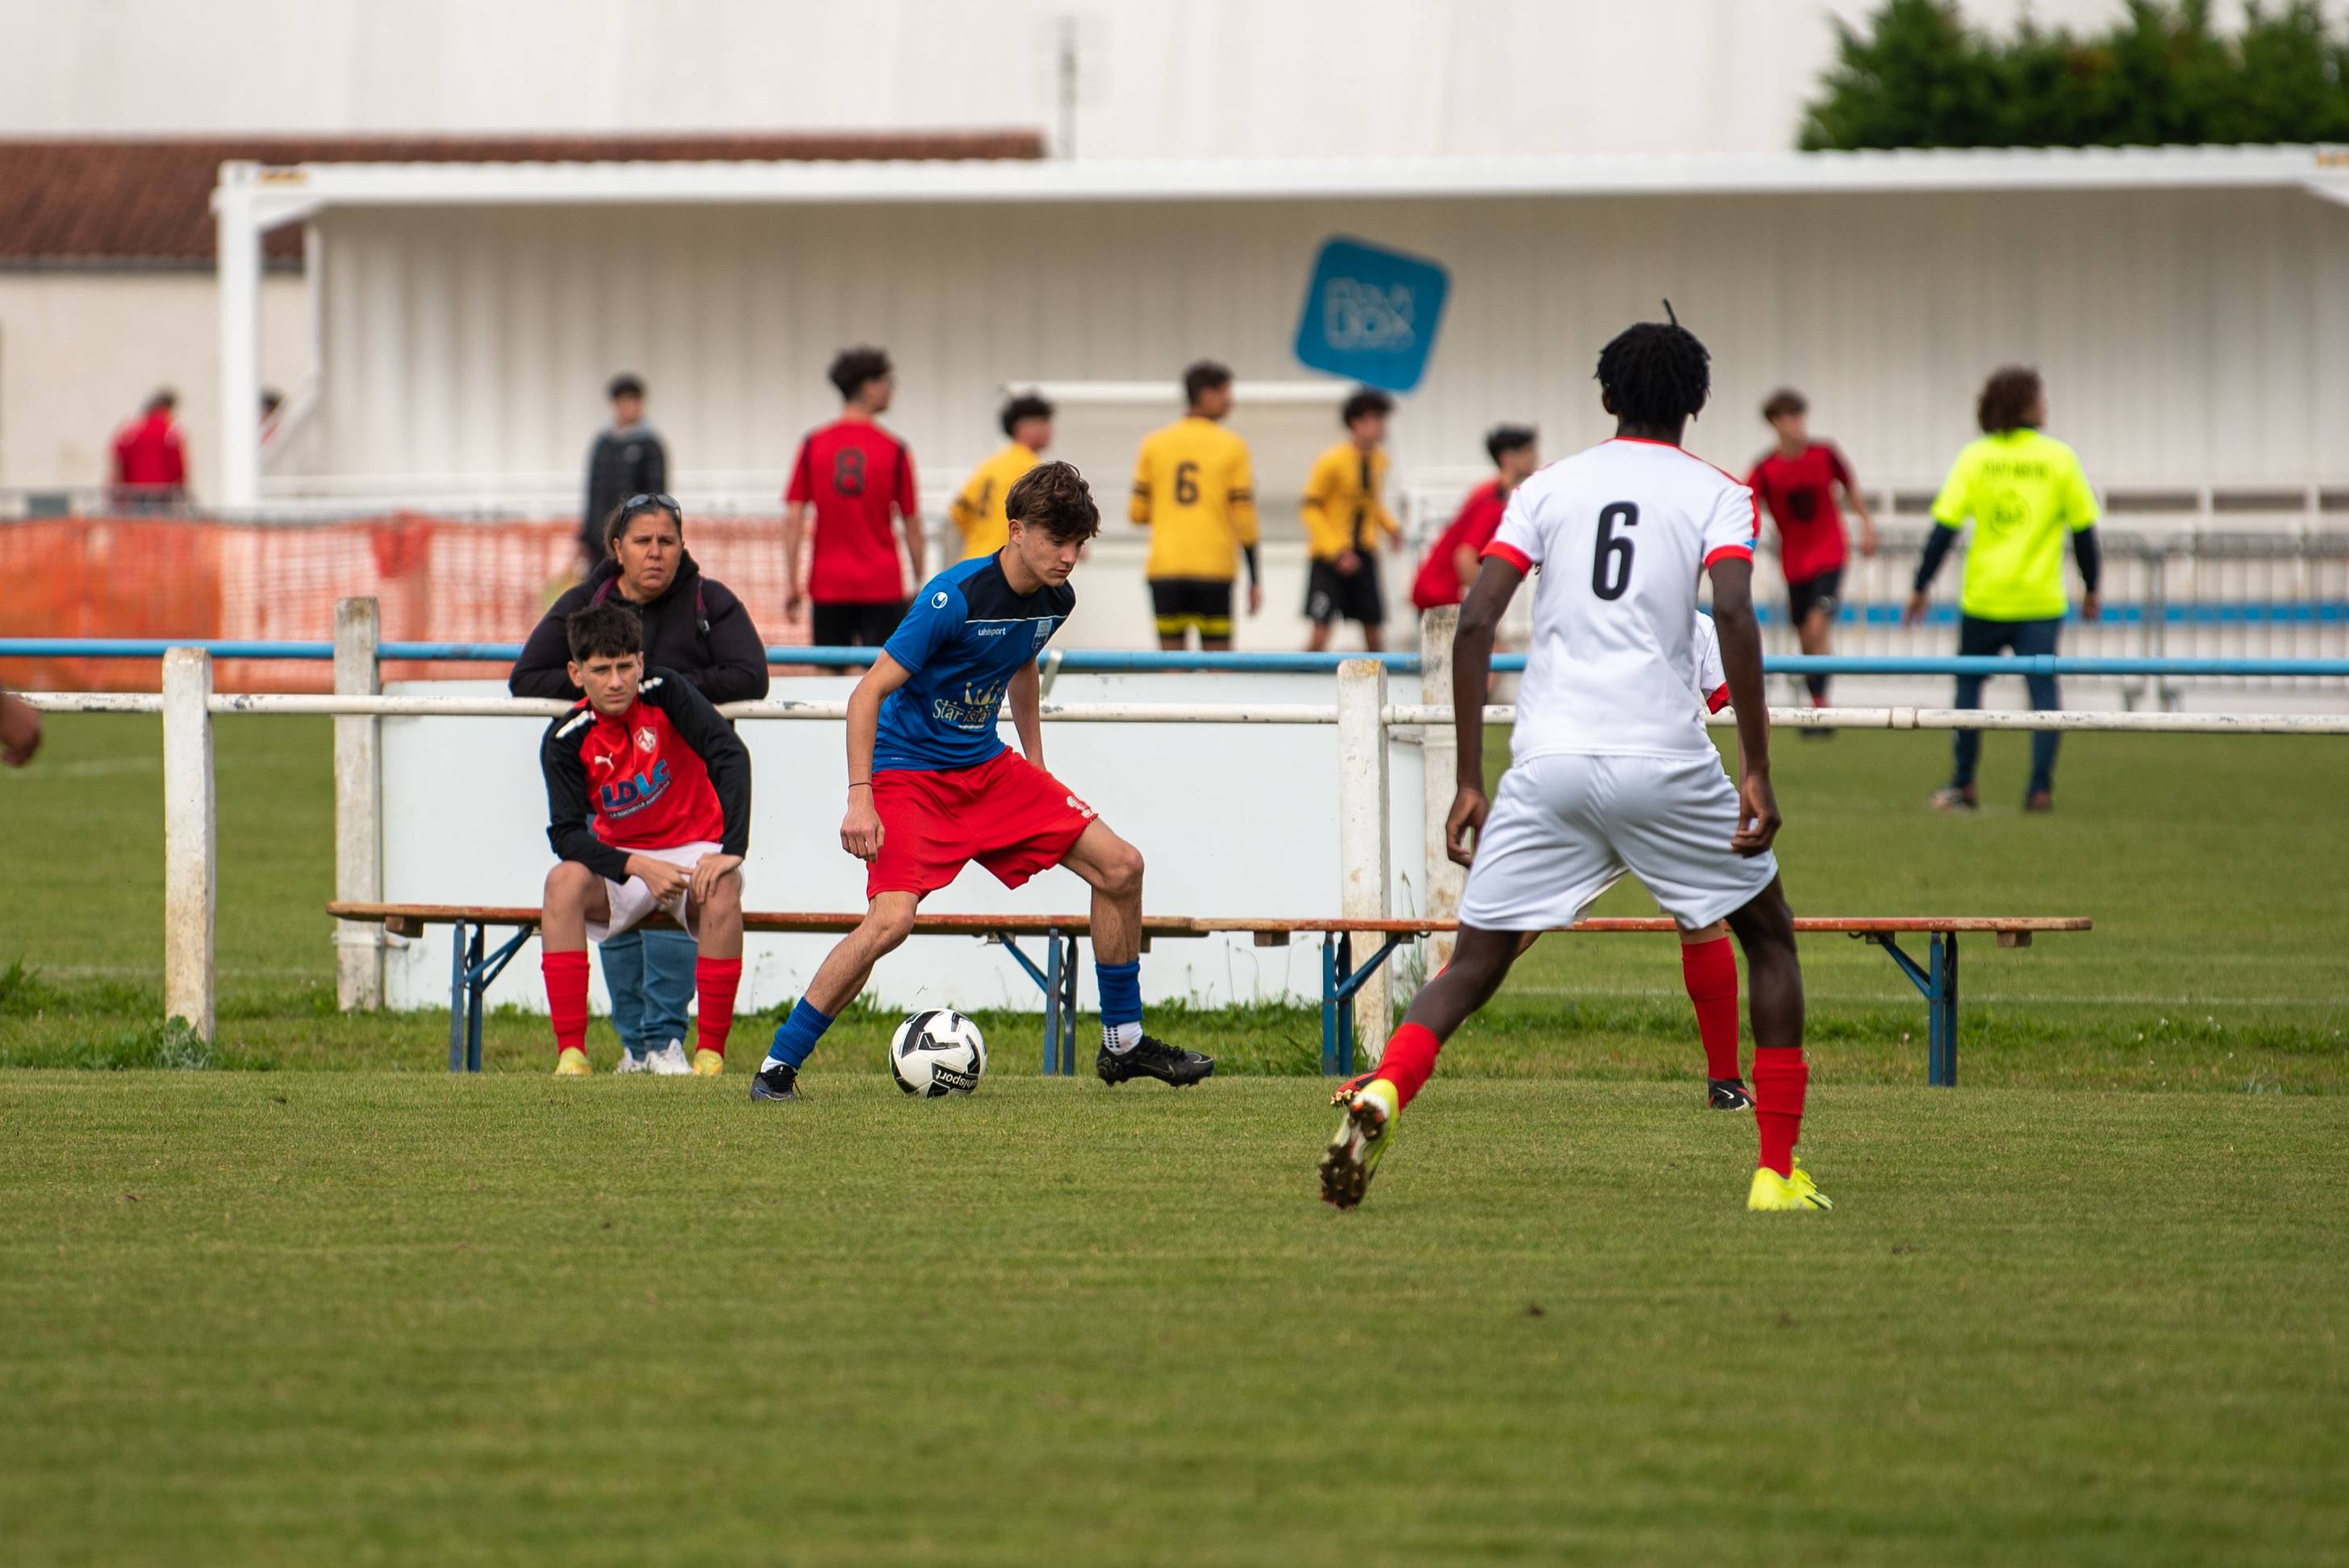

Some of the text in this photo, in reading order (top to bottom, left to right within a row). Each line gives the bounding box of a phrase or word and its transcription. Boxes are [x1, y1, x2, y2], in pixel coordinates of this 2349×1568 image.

[833, 447, 866, 497] 8
[1174, 461, 1200, 507] 6
[1592, 500, 1639, 601] 6
[978, 626, 1007, 637] uhlsport
[933, 699, 964, 722] Star
[601, 759, 670, 809] LDLC
[936, 1069, 977, 1089] uhlsport
